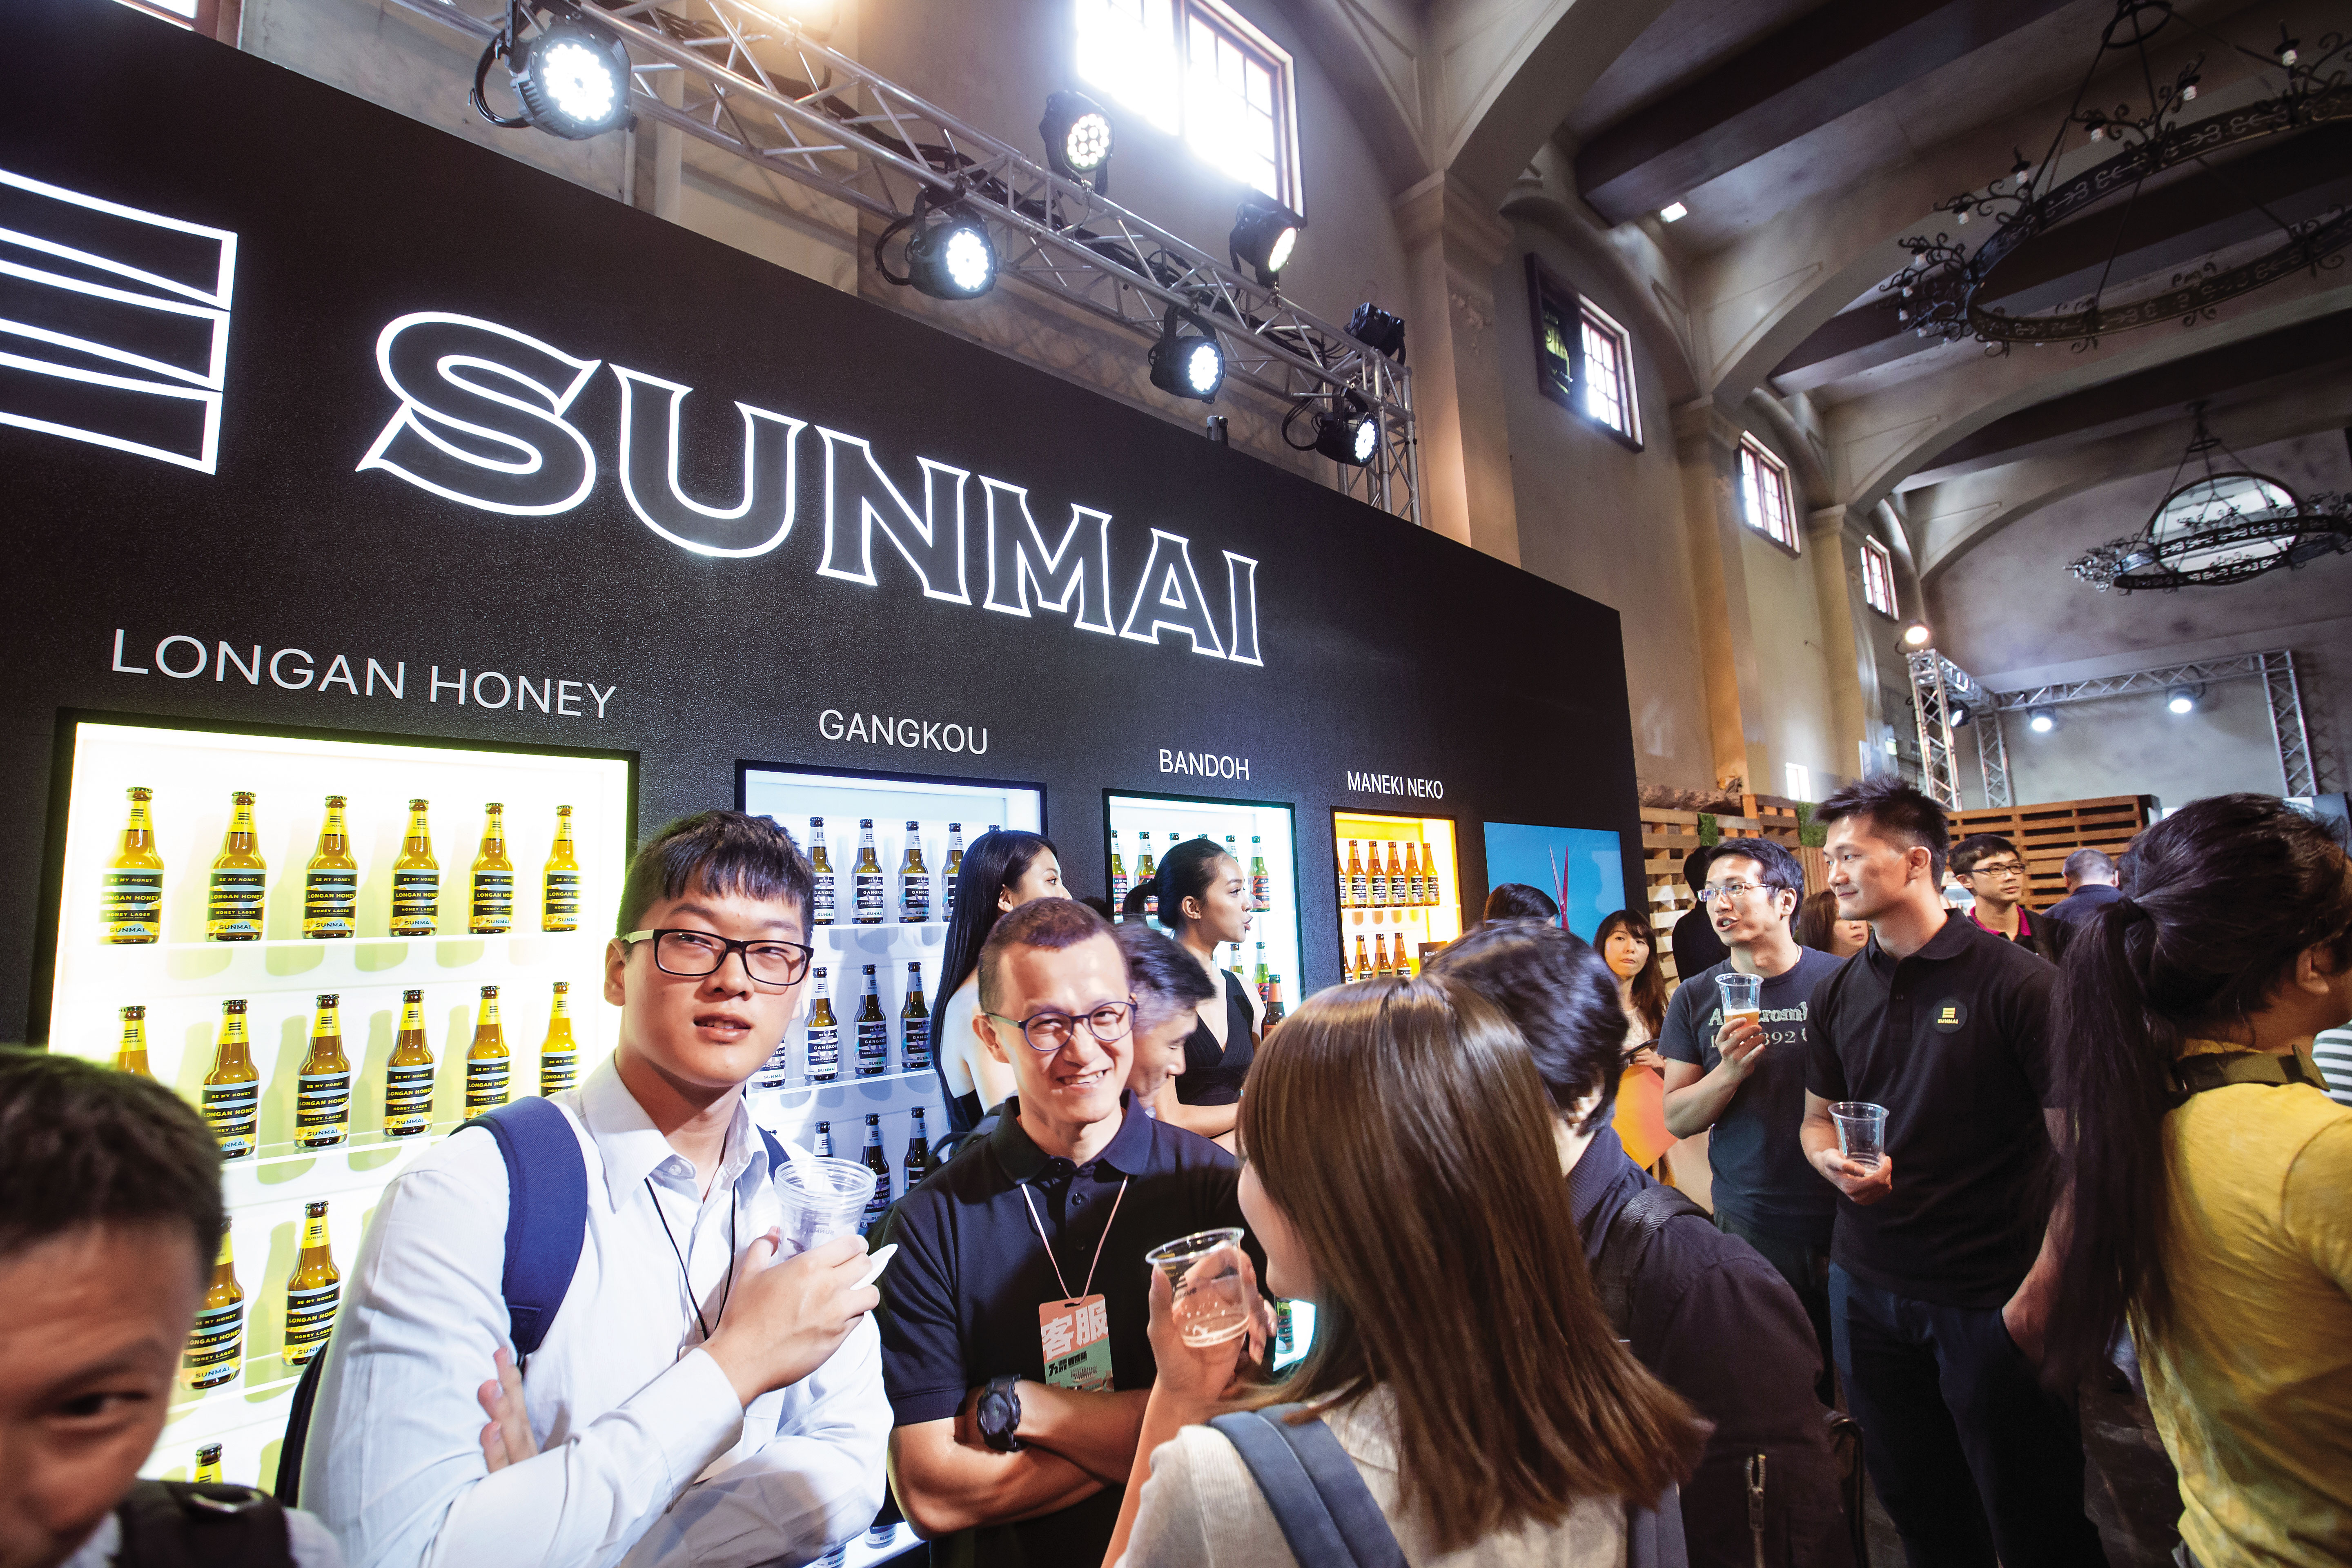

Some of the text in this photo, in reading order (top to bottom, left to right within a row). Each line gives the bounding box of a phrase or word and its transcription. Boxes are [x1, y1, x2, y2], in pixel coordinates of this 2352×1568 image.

[355, 311, 1264, 667] SUNMAI
[111, 628, 617, 719] LONGAN HONEY
[819, 709, 987, 755] GANGKOU
[1159, 748, 1250, 780] BANDOH
[1348, 771, 1443, 799] MANEKI NEKO
[316, 1294, 334, 1302] HONEY
[216, 1314, 236, 1322] HONEY
[319, 1309, 336, 1319] HONE
[219, 1328, 241, 1340] HONEY
[1040, 1299, 1108, 1360] 客服
[216, 1349, 234, 1358] LAGER
[196, 1366, 229, 1378] SUNMAI
